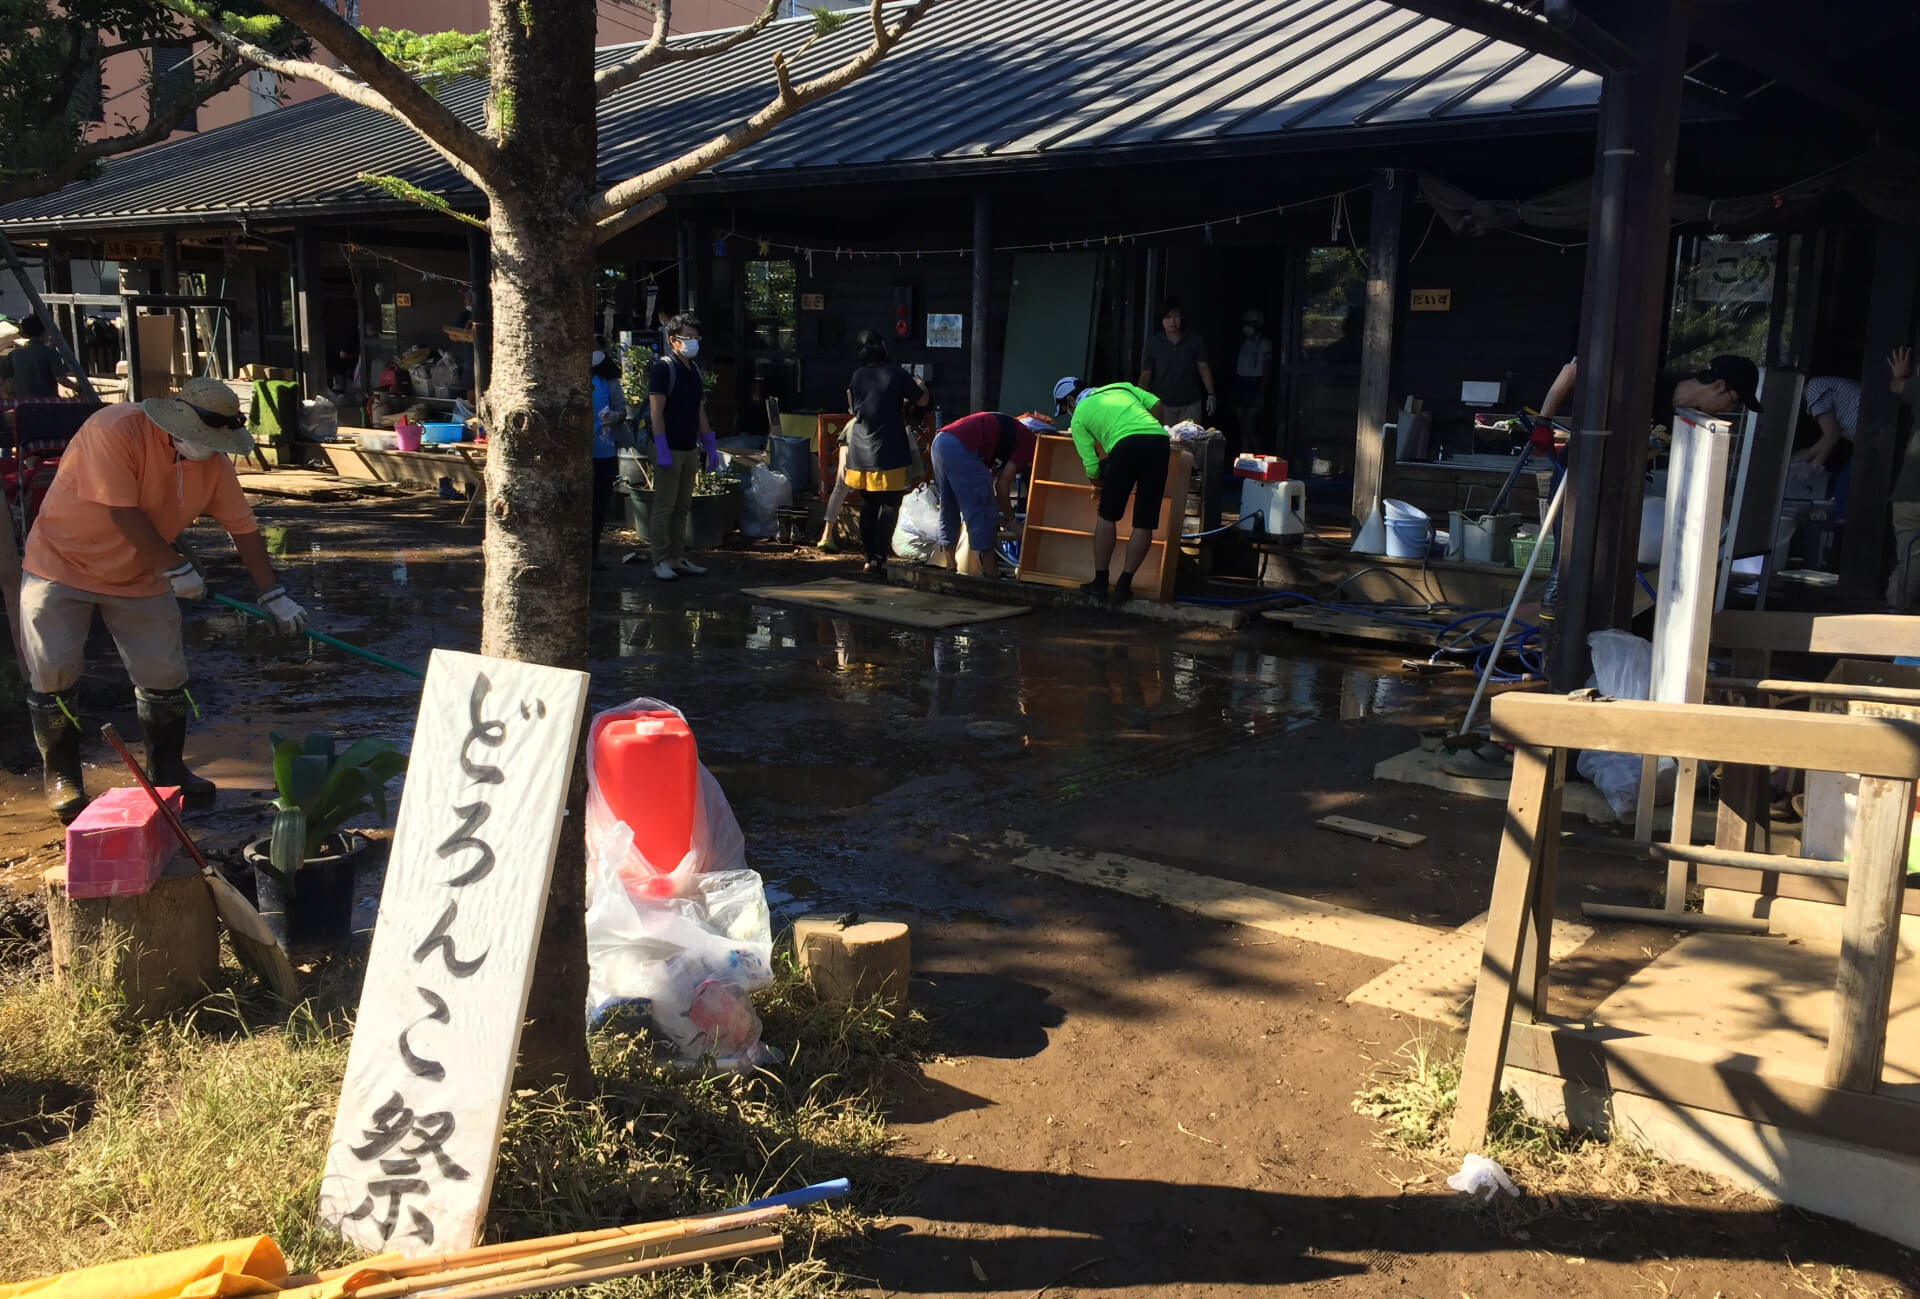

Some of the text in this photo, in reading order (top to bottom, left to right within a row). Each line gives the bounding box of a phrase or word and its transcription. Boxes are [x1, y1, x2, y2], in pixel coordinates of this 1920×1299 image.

[342, 671, 546, 1247] どろんこ祭
